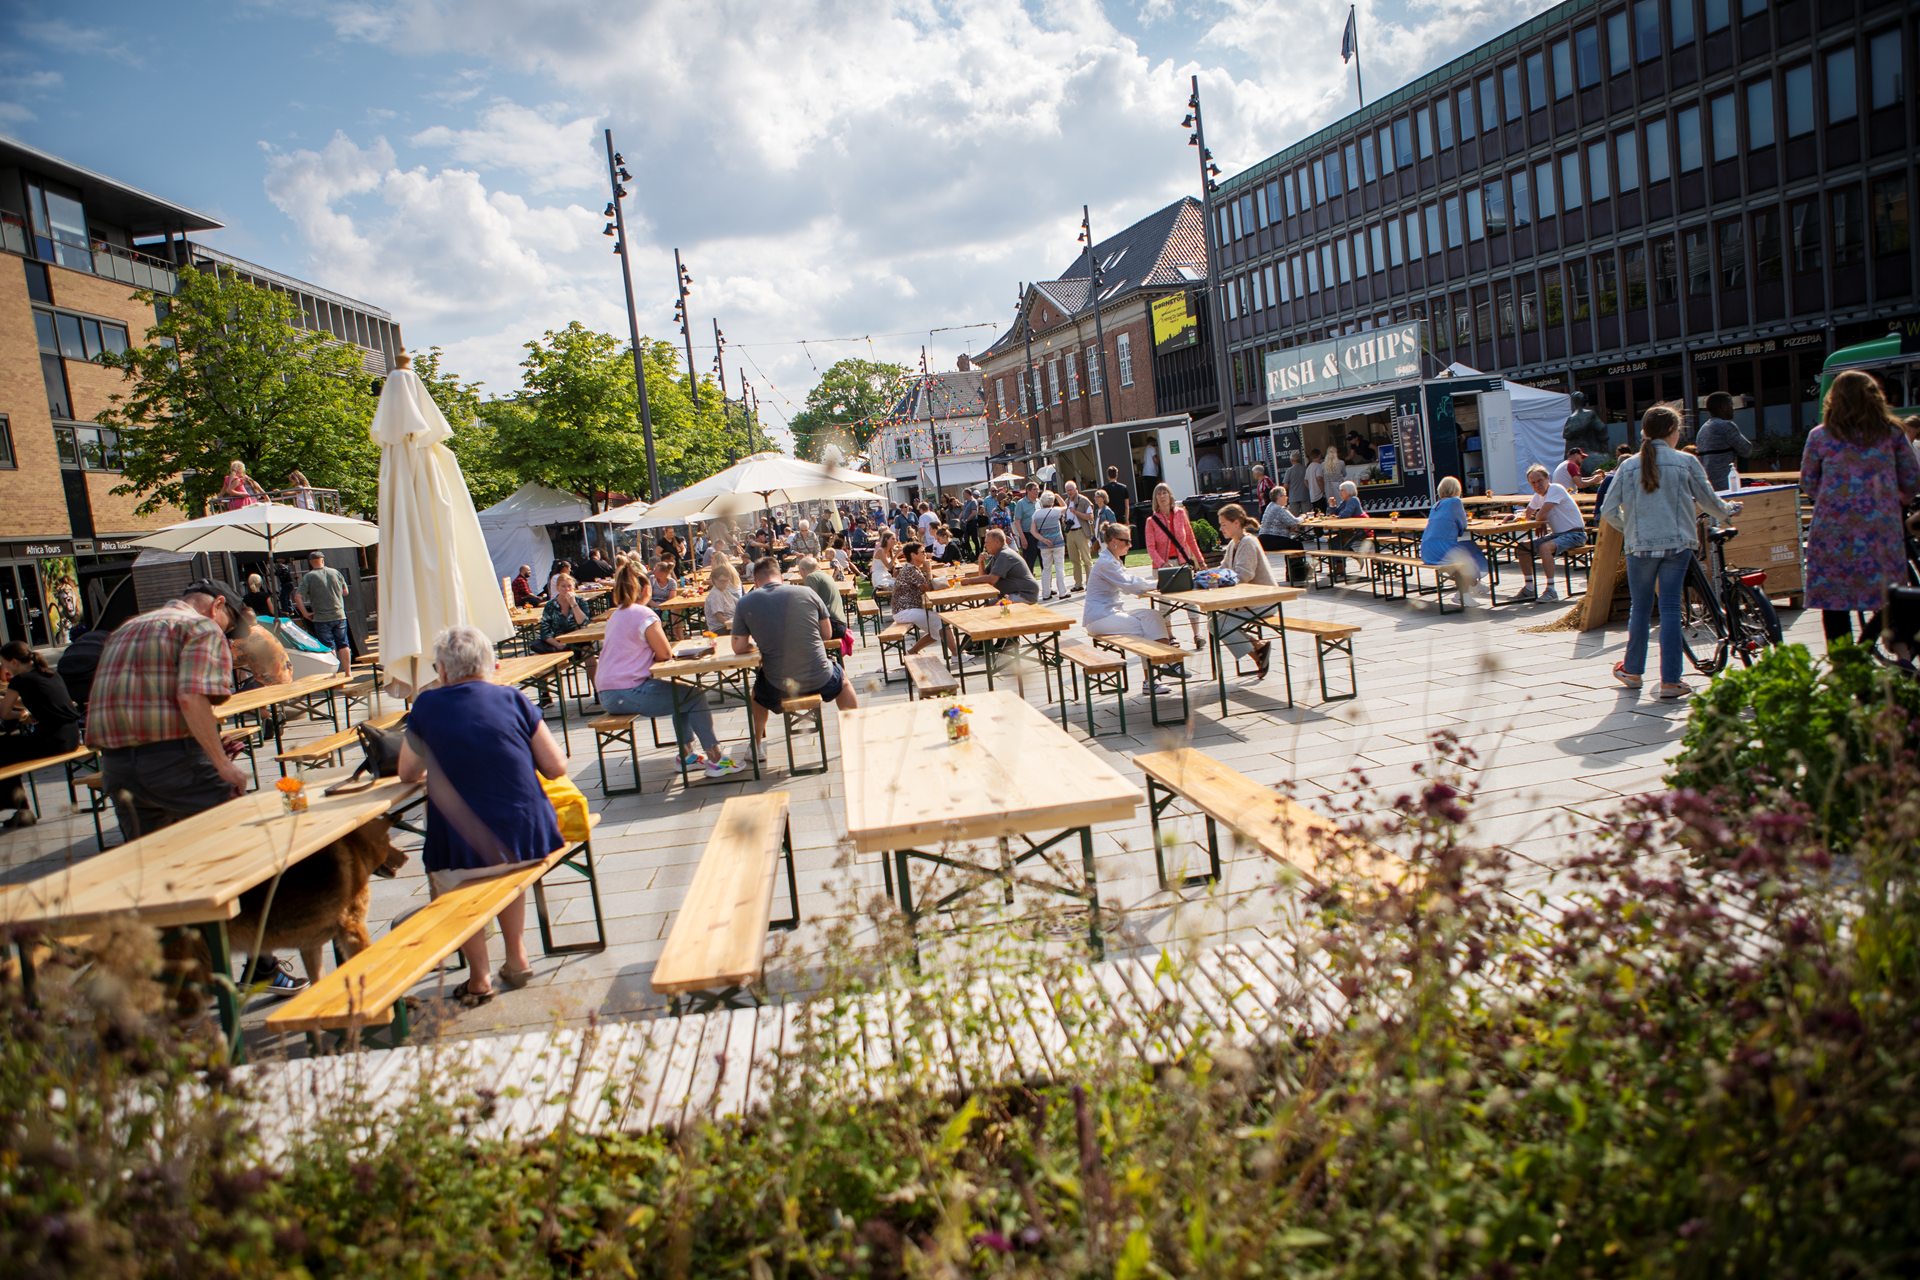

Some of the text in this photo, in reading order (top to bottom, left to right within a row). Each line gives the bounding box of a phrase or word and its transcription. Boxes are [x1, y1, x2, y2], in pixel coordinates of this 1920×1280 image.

[1694, 346, 1742, 362] RISTORANTE
[1783, 333, 1822, 348] PIZZERIA
[1267, 327, 1416, 395] FISH & CHIPS
[1608, 364, 1626, 375] CAFE
[1632, 362, 1648, 371] BAR
[26, 544, 62, 555] Africa Tours
[101, 541, 118, 550] Africa
